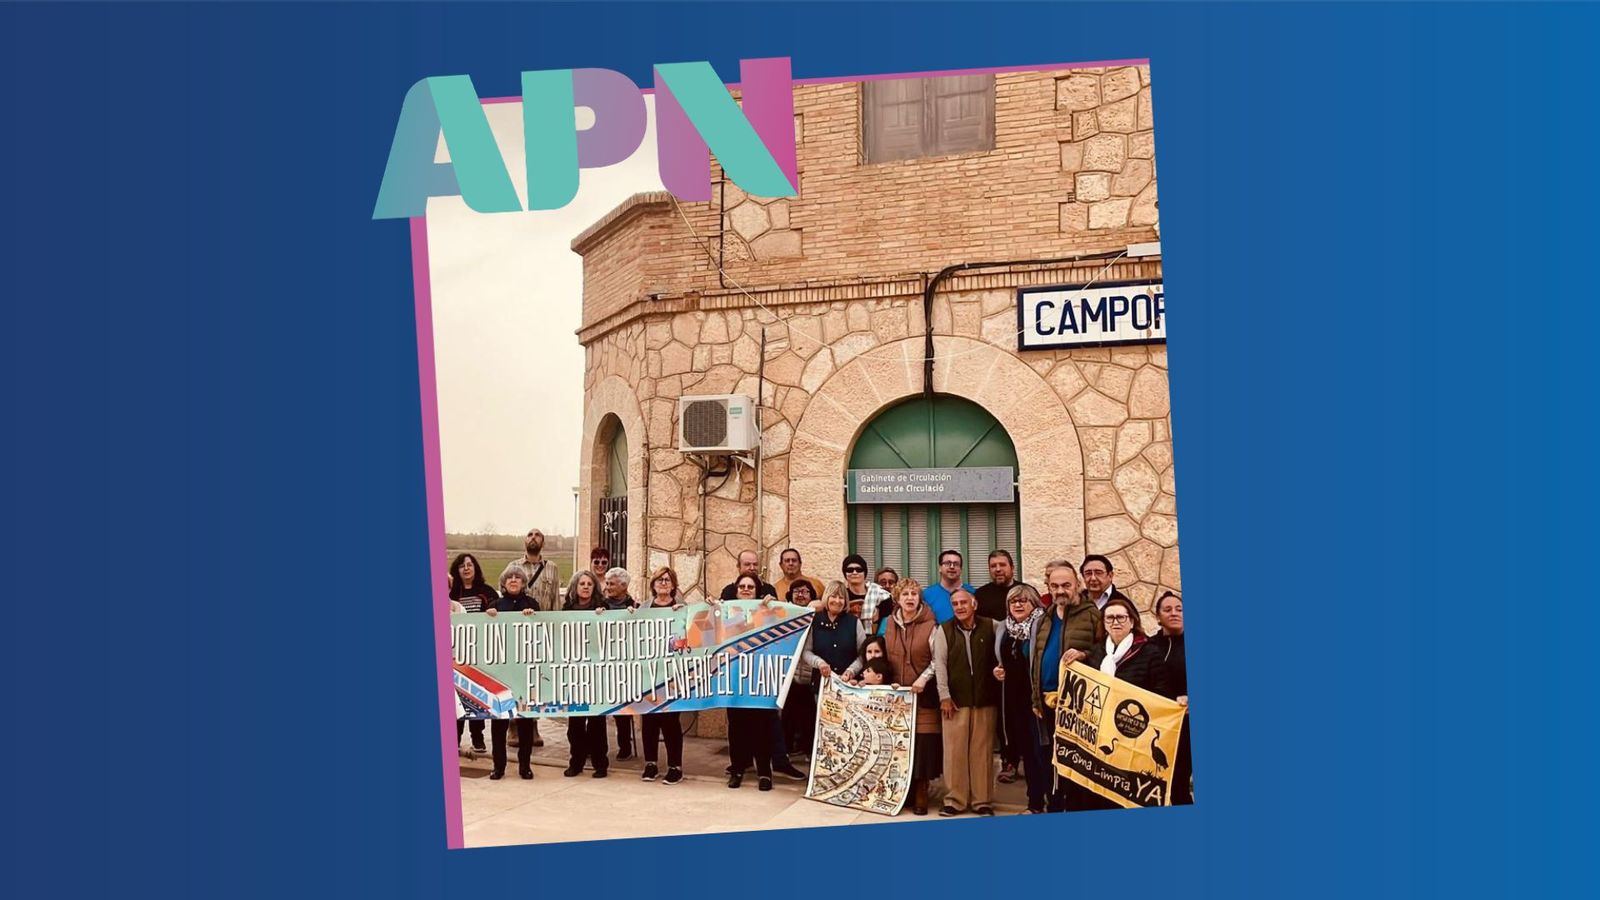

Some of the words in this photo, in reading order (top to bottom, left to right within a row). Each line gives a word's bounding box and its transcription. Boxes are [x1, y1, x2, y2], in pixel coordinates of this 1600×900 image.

[860, 474, 897, 483] Gabinete
[898, 474, 907, 482] de
[909, 472, 952, 482] Circulación
[860, 484, 892, 493] Gabinet
[894, 484, 904, 493] de
[906, 483, 945, 493] Circulació
[483, 622, 508, 665] UN
[512, 620, 557, 664] TREN
[560, 617, 591, 663] QUE
[596, 617, 675, 663] VERTEBRE
[527, 664, 546, 707] EL
[550, 662, 643, 705] TERRITORIO
[647, 660, 659, 701] Y
[664, 649, 713, 700] ENFRÍE
[717, 654, 734, 696] EL
[1059, 671, 1087, 714] NO
[1056, 743, 1093, 771] arisma
[1136, 777, 1163, 806] YA
